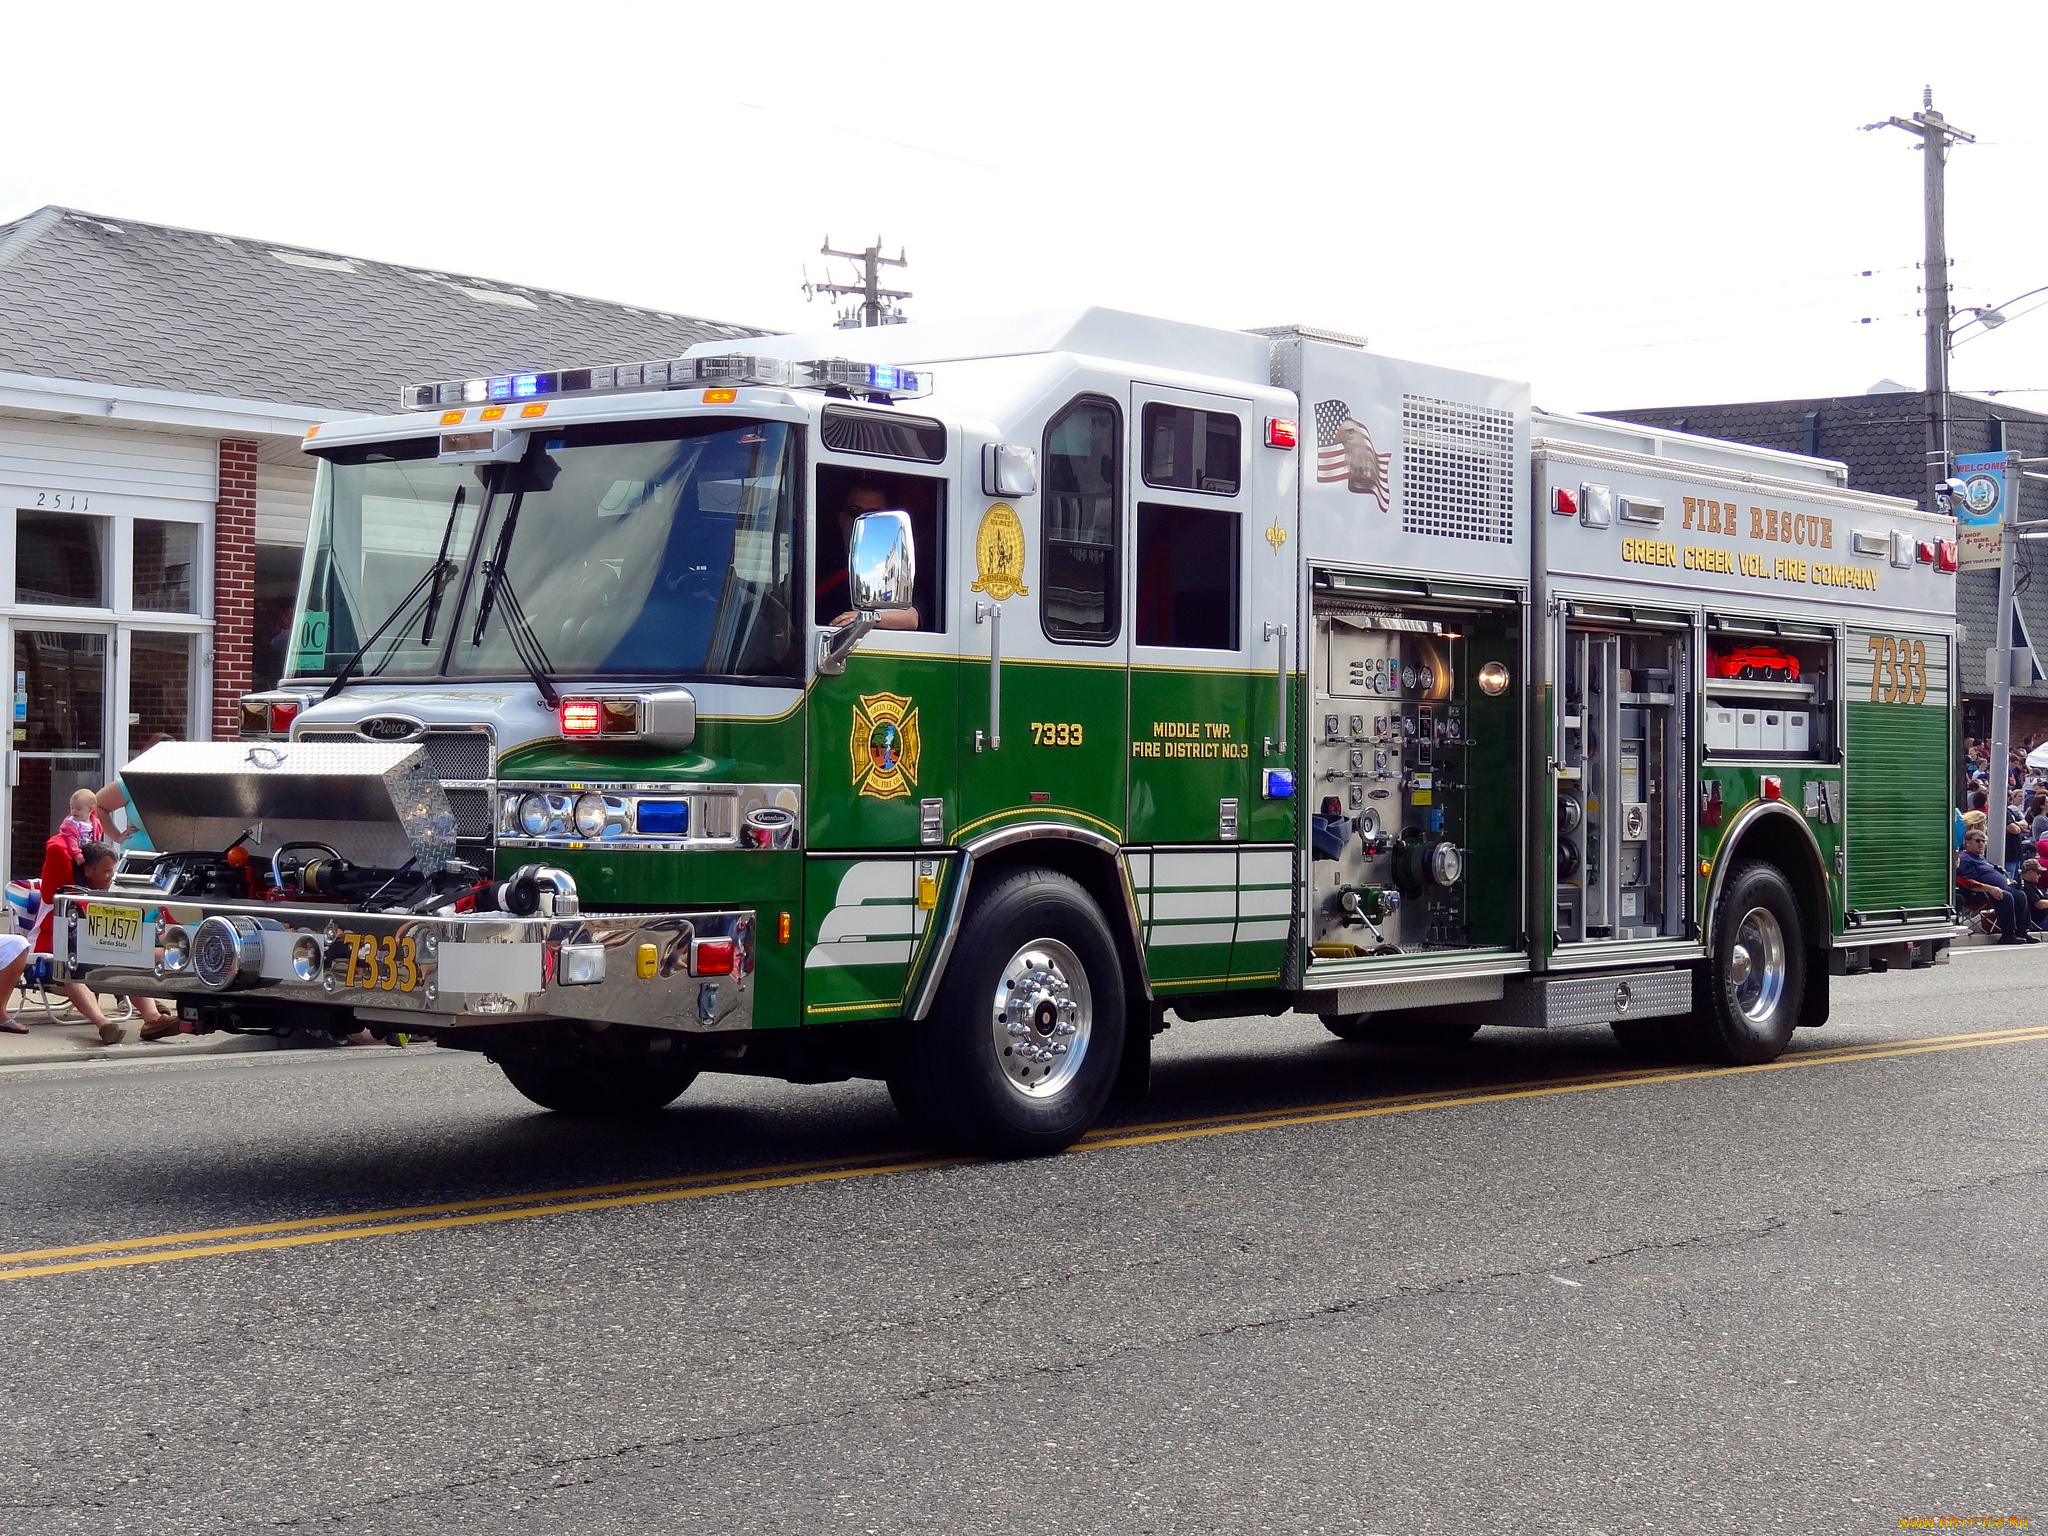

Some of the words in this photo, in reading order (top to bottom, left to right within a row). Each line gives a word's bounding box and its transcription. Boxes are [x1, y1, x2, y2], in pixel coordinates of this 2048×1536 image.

[1957, 461, 2007, 473] WELCOME
[36, 492, 89, 511] 2511
[1682, 496, 1737, 536] FIRE
[1750, 507, 1833, 549] RESCUE
[1622, 537, 1677, 568] GREEN
[1684, 545, 1735, 575] CREEK
[1739, 552, 1771, 579] VOL.
[1774, 557, 1806, 583] FIRE
[1811, 562, 1880, 591] COMPANY
[1868, 635, 1927, 704] 7333
[870, 703, 886, 715] GREEN
[886, 703, 901, 715] CREEK
[371, 719, 407, 737] Pierce
[1030, 722, 1083, 747] 7333
[1153, 722, 1200, 739] MIDDLE
[1204, 722, 1231, 739] TWP.
[1132, 741, 1161, 758] FIRE
[1164, 742, 1220, 758] DISTRICT
[88, 914, 138, 940] NF14577
[115, 940, 128, 948] State
[343, 933, 417, 993] 7333
